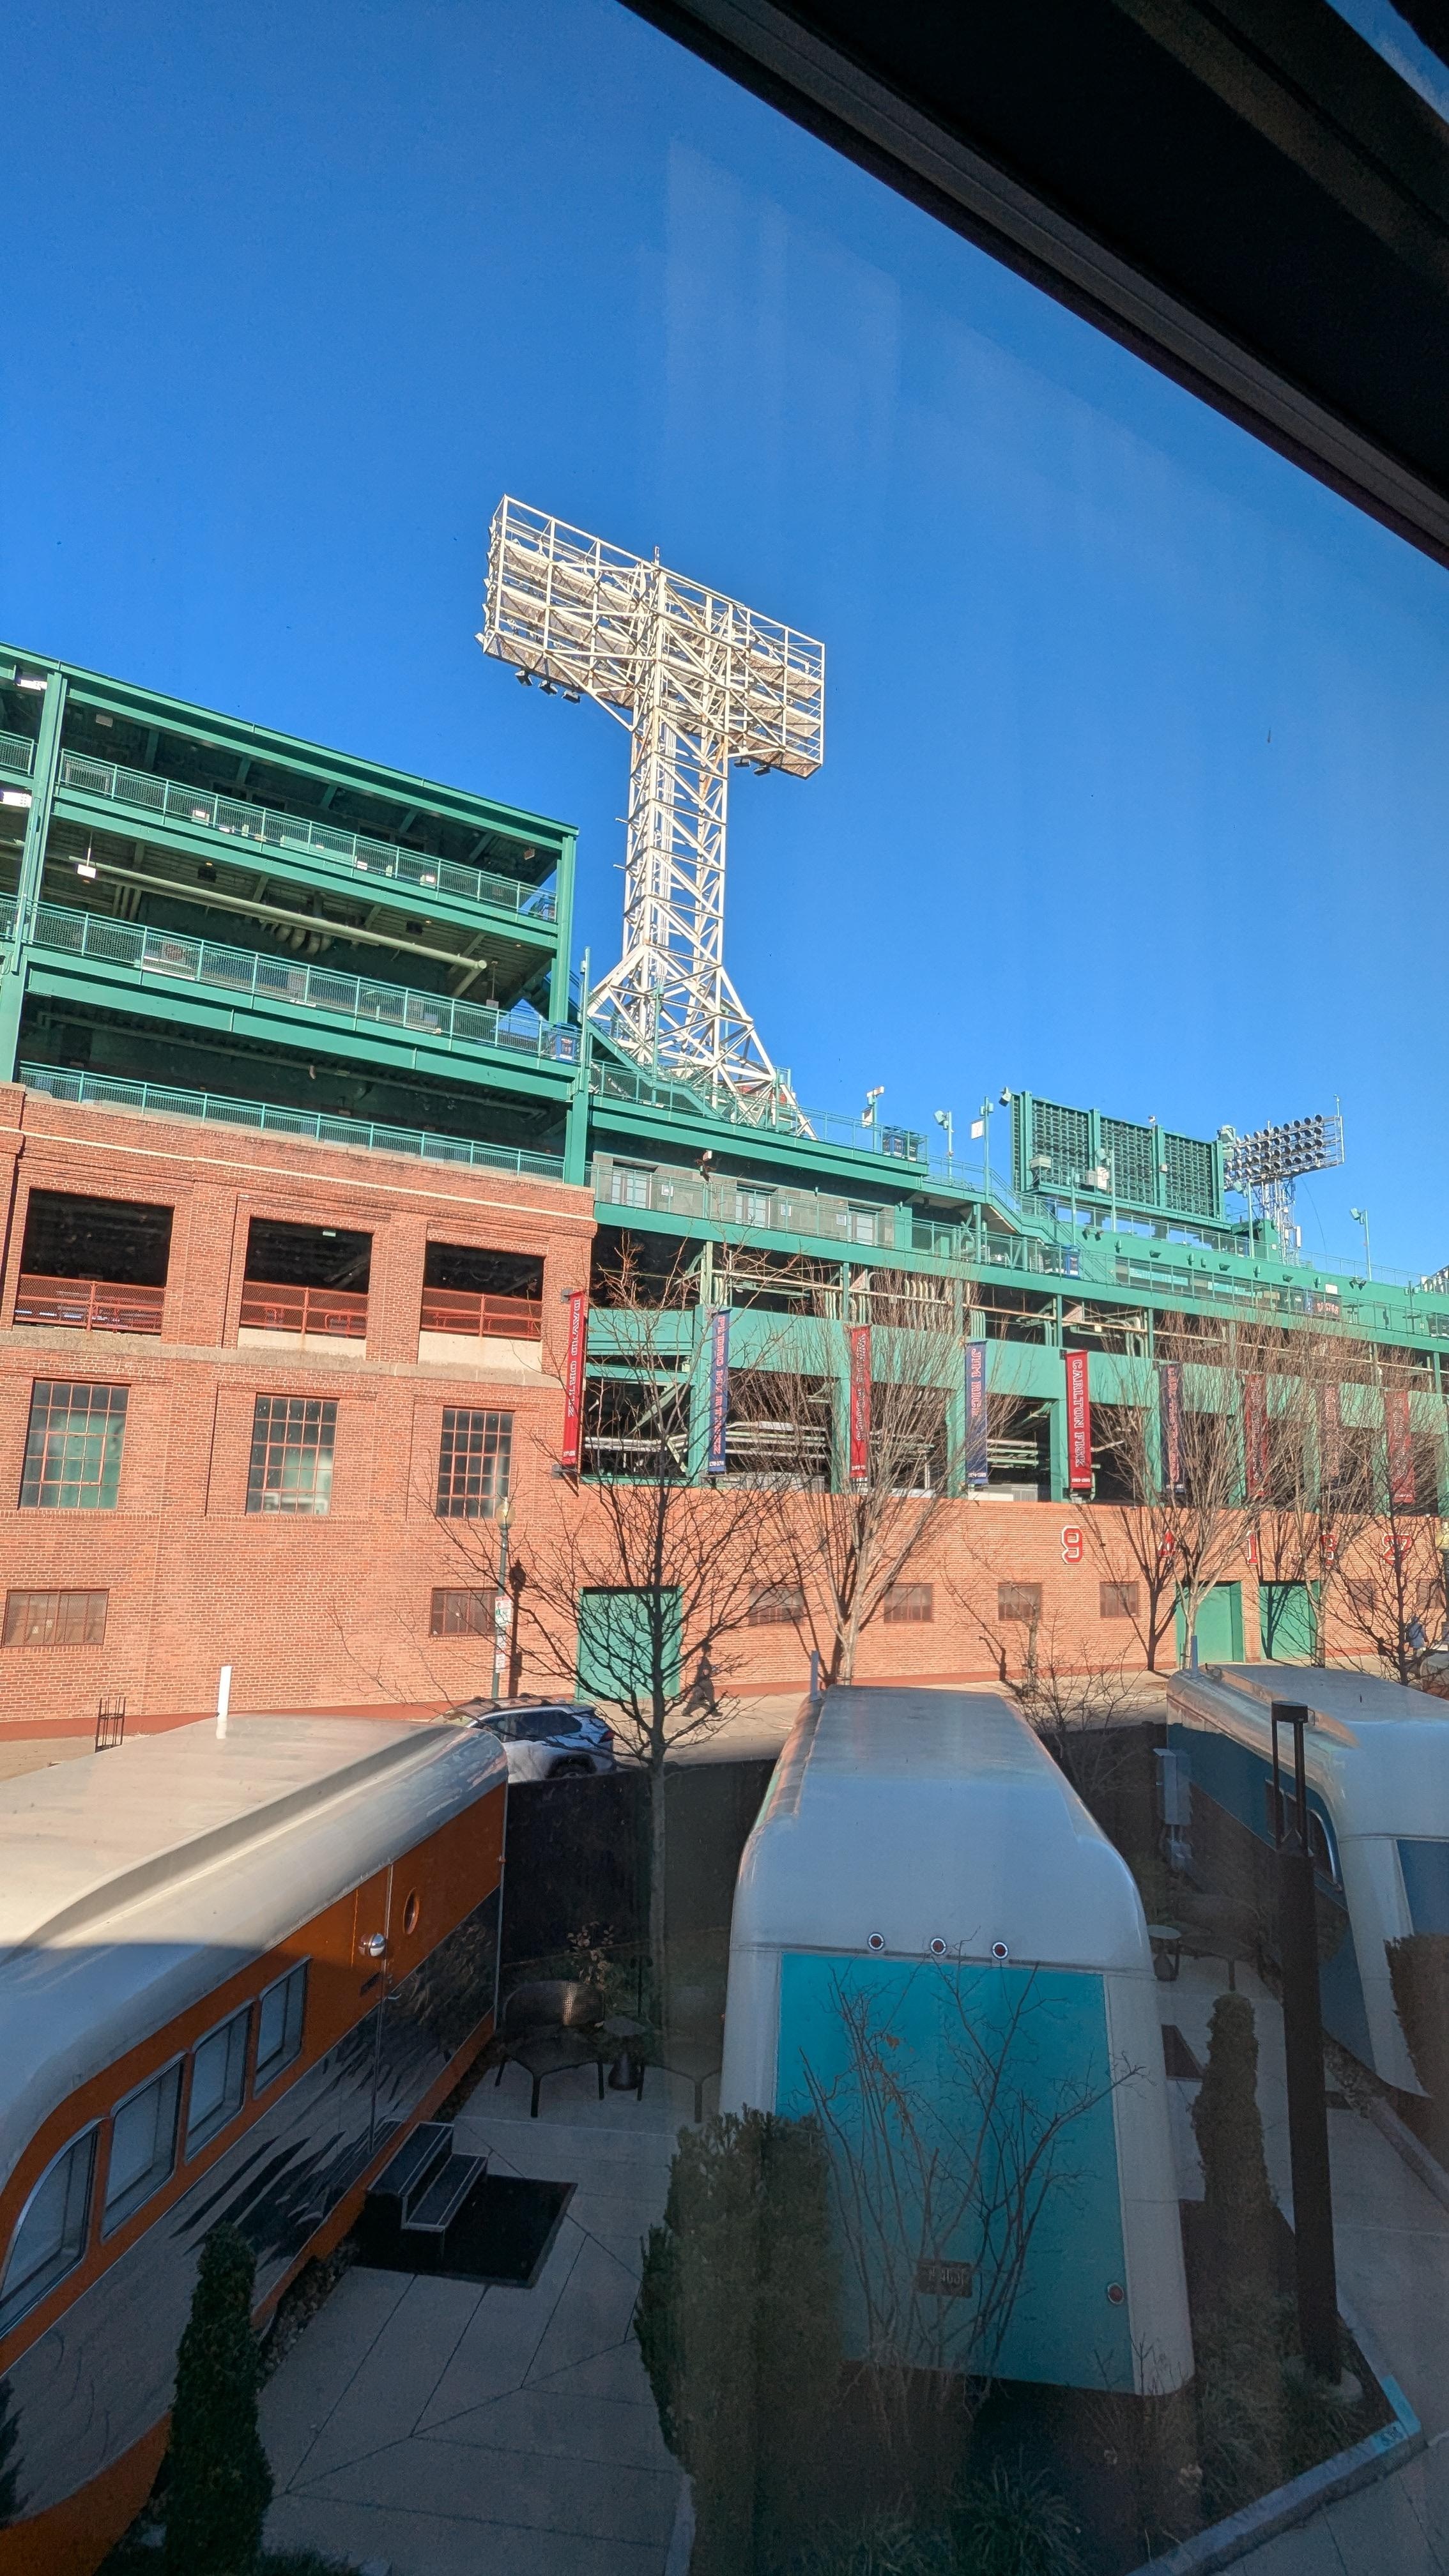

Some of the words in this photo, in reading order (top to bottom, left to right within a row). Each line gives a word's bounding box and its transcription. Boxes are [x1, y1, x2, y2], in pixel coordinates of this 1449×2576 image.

[571, 1299, 581, 1356] DAVID
[716, 1316, 726, 1367] PEDRO
[971, 1348, 981, 1377] JIM
[568, 1361, 577, 1417] ORTIZ
[971, 1382, 982, 1417] RICE
[1072, 1360, 1084, 1429] CARLTON
[1075, 1432, 1085, 1468] FISK
[1061, 1525, 1084, 1564] 9
[1245, 1530, 1259, 1565] 1
